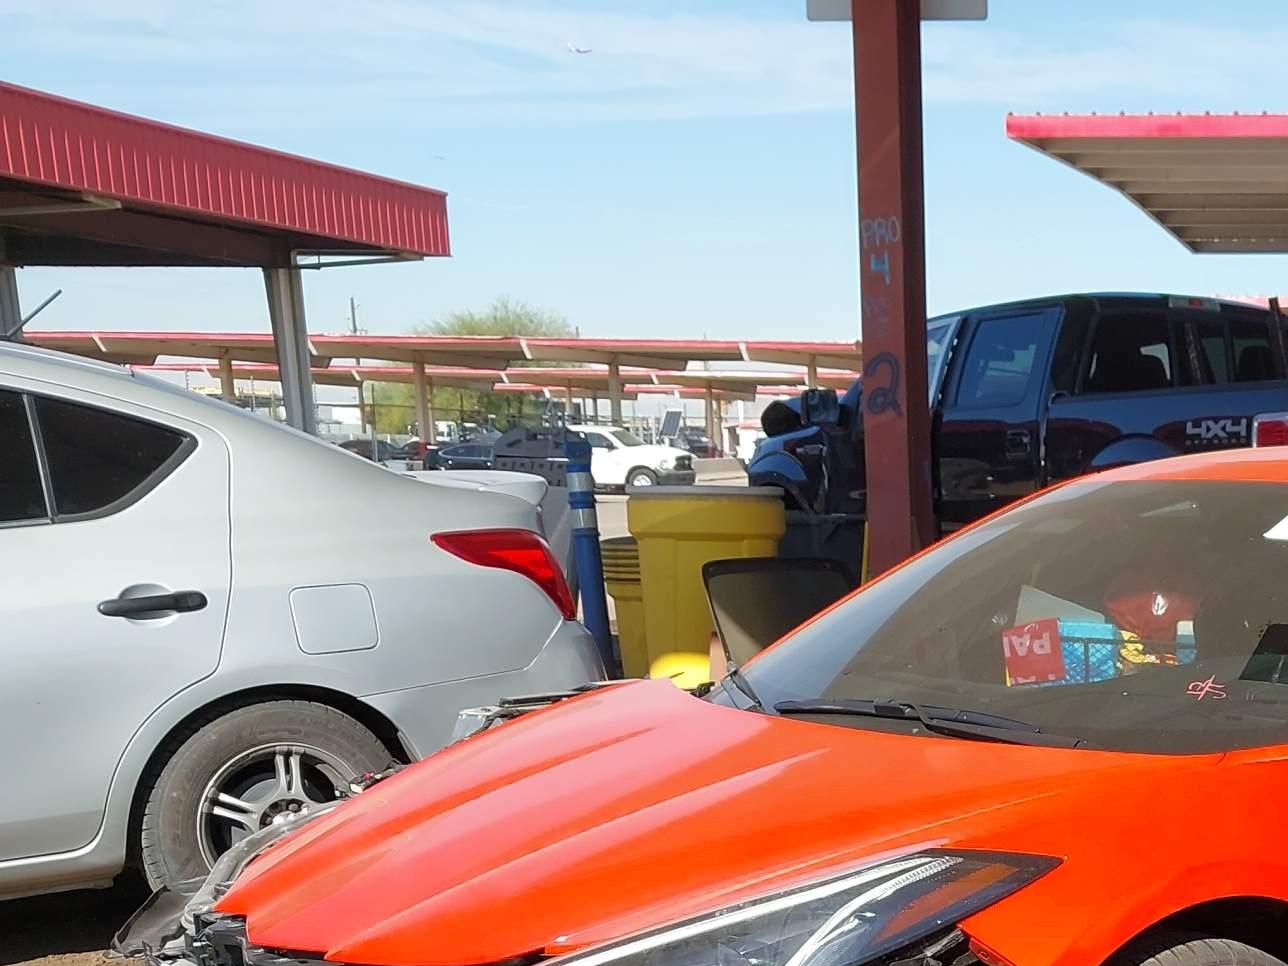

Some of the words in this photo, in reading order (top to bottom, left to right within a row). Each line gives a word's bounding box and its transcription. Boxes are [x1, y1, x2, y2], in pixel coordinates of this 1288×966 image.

[861, 216, 900, 248] PRO
[870, 252, 891, 285] 4
[865, 351, 903, 416] 2
